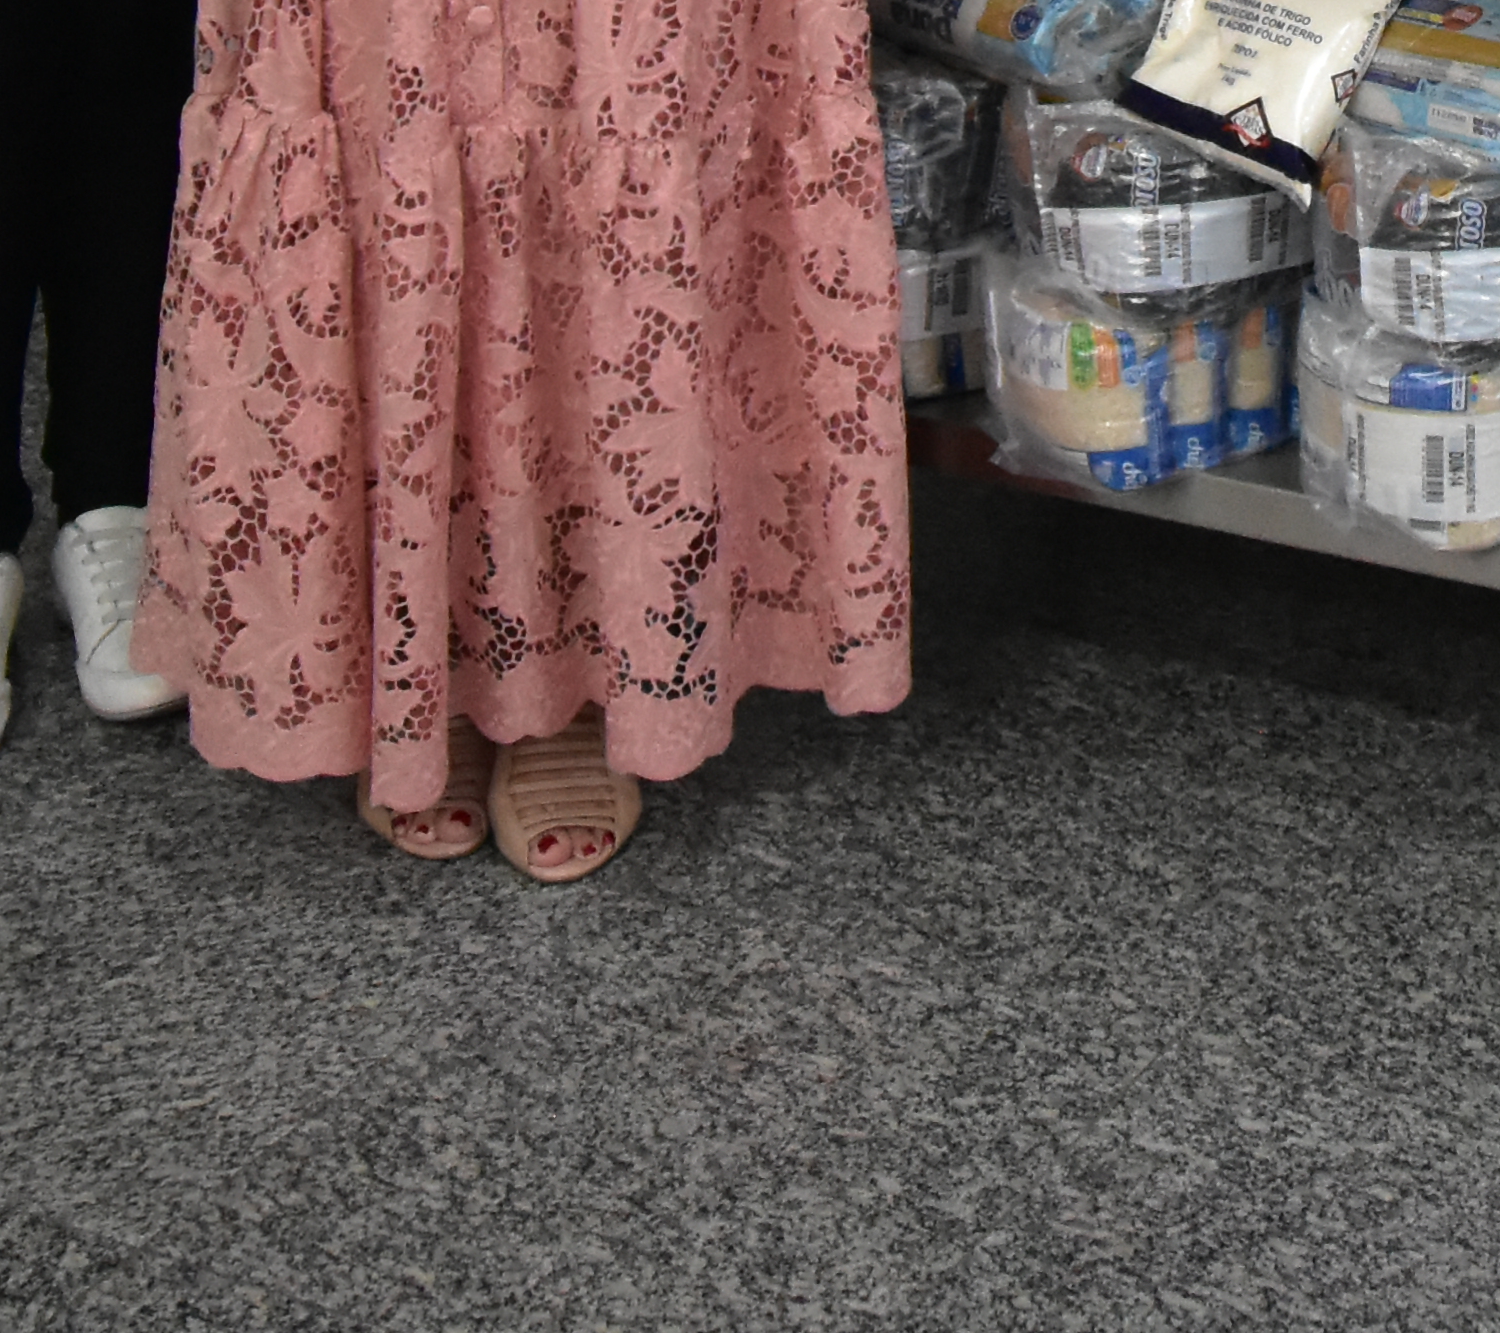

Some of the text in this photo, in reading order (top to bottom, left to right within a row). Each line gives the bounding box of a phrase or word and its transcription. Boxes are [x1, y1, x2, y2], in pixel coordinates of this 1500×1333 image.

[1263, 1, 1279, 15] DE
[1279, 6, 1312, 26] TRIGO
[1261, 14, 1285, 31] COM
[1286, 22, 1324, 46] FERRO
[1448, 450, 1466, 488] DUN-14
